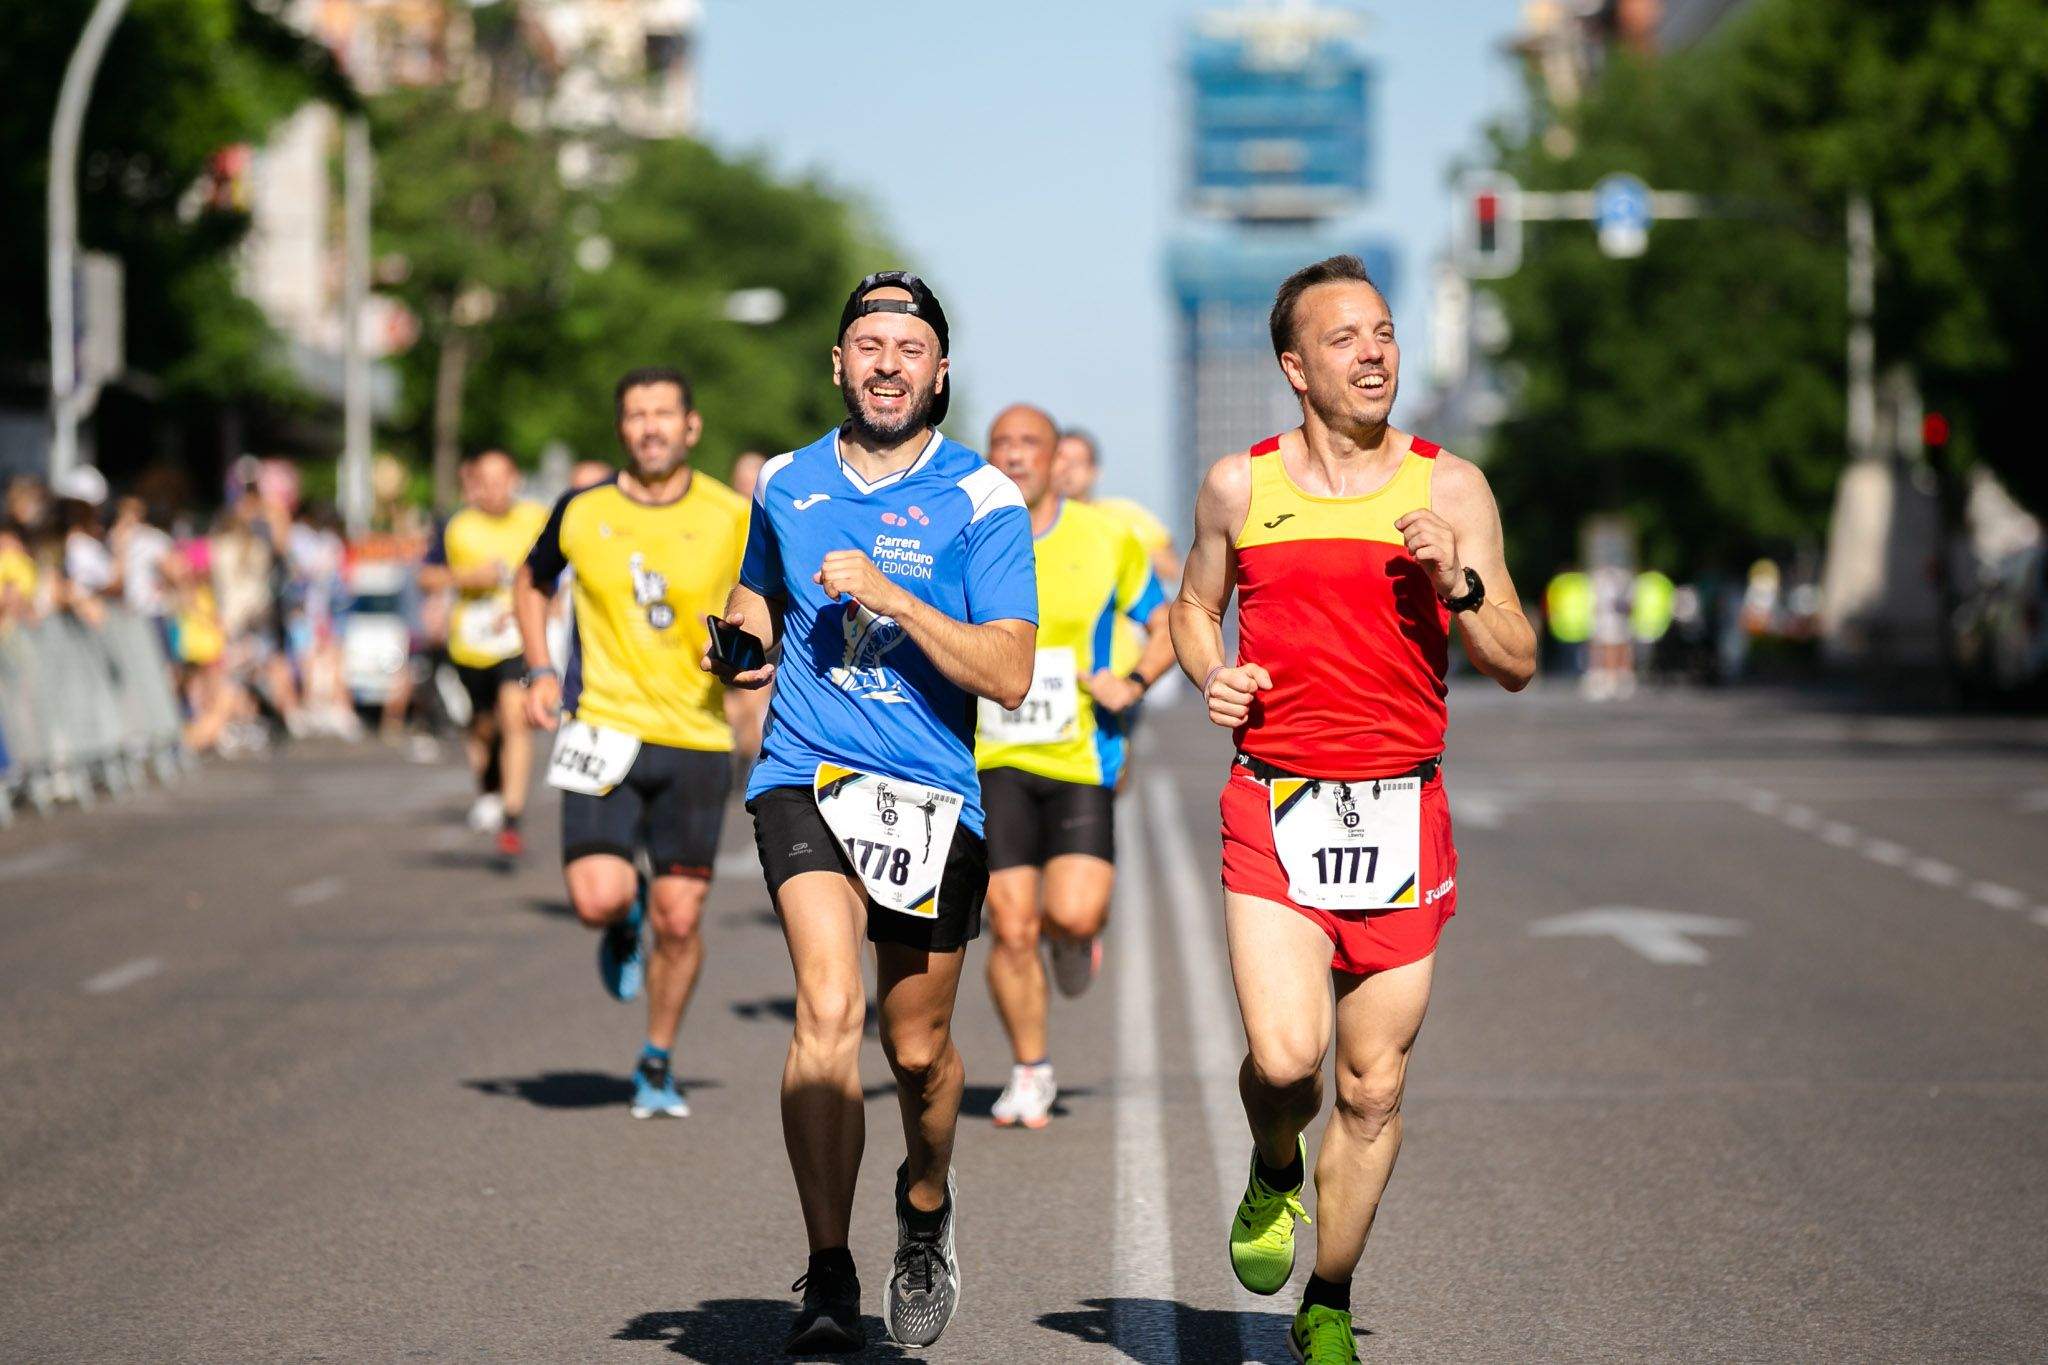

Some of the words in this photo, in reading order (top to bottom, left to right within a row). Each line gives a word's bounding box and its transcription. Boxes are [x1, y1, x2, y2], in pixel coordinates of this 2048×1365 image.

[876, 534, 920, 549] Carrera
[873, 546, 934, 565] ProFuturo
[882, 561, 932, 579] EDICIÓN
[884, 812, 896, 822] 13
[1346, 815, 1358, 825] 13
[843, 837, 912, 887] 1778
[1312, 847, 1379, 884] 1777
